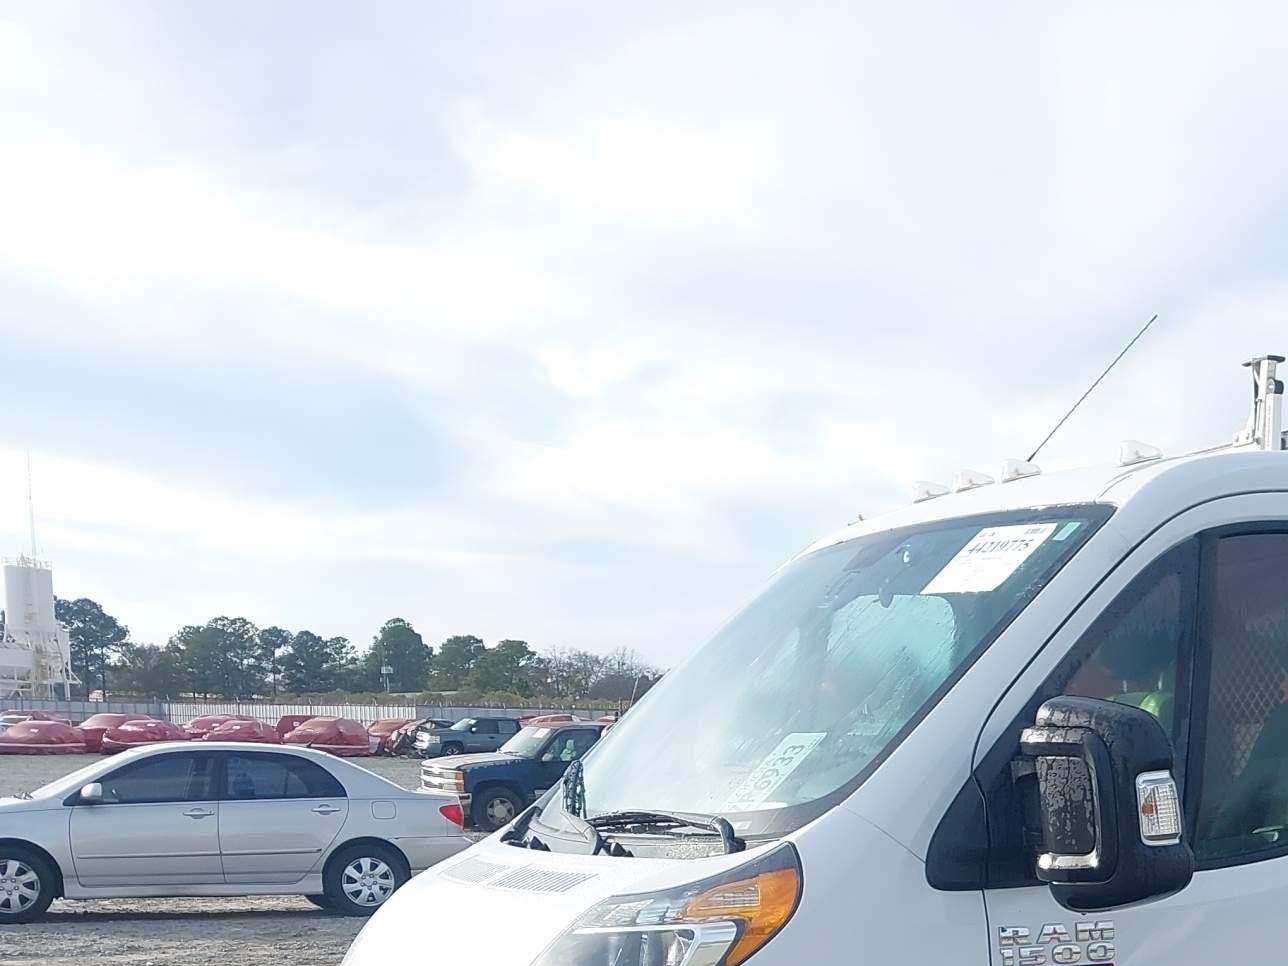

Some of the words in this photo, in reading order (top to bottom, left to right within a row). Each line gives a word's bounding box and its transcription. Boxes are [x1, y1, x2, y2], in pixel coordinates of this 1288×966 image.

[968, 539, 1034, 554] 44219775
[998, 920, 1115, 946] RAM
[999, 941, 1115, 966] 1500
